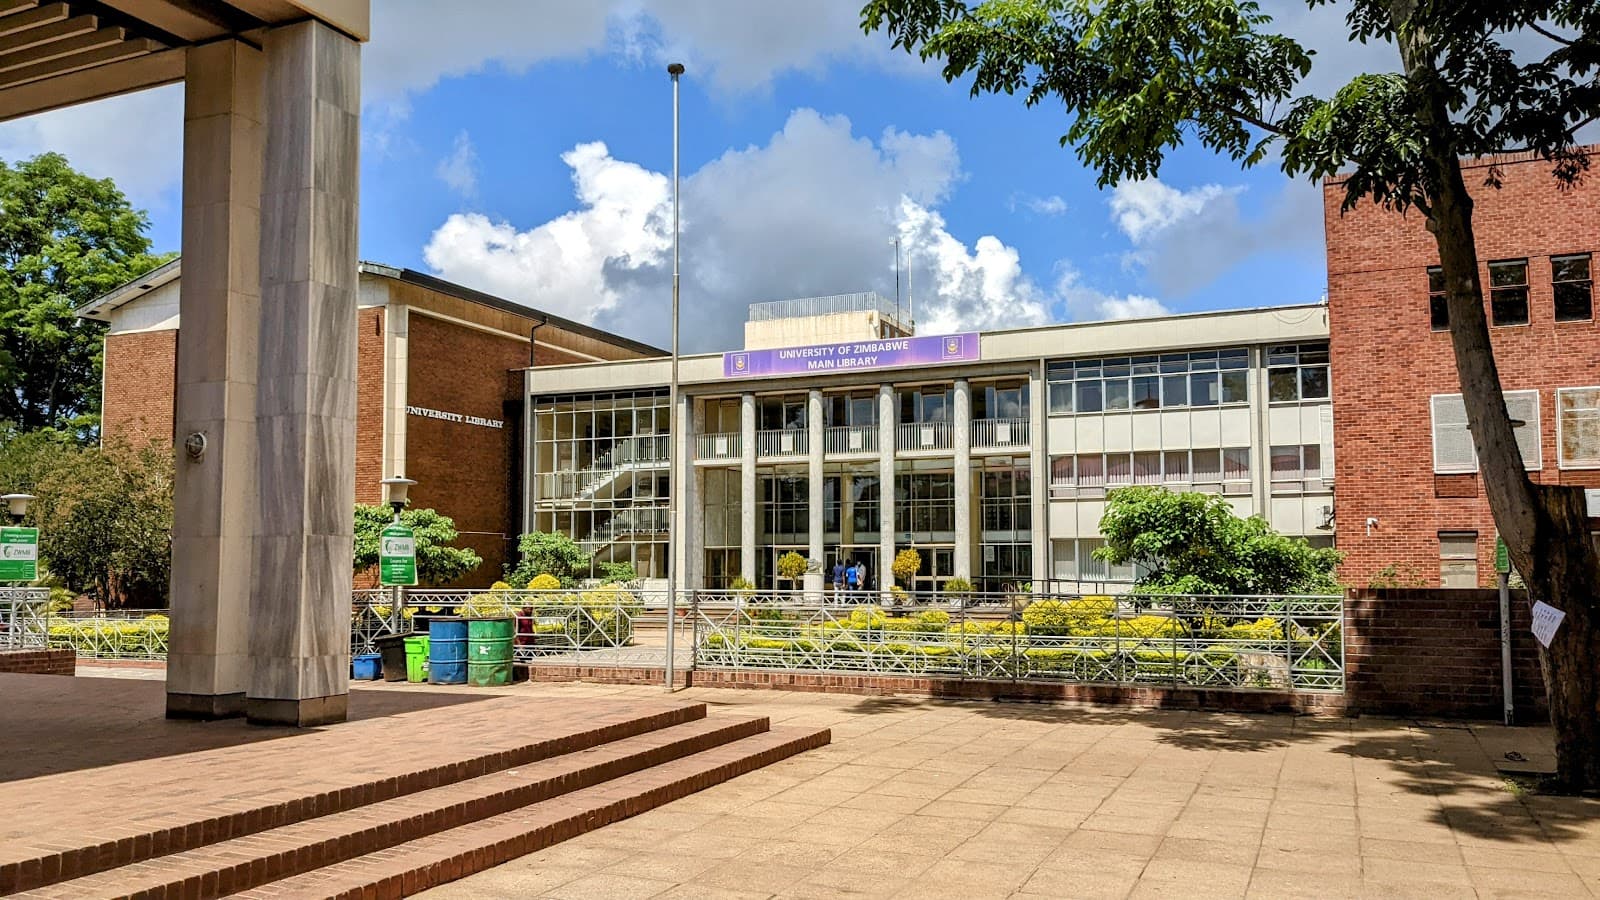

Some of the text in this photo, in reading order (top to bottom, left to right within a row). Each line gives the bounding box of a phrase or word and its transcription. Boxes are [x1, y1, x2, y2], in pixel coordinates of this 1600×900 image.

[779, 341, 909, 359] UNIVERSITY OF ZIMBABWE
[807, 356, 878, 370] MAIN LIBRARY
[465, 415, 504, 429] LIBRARY
